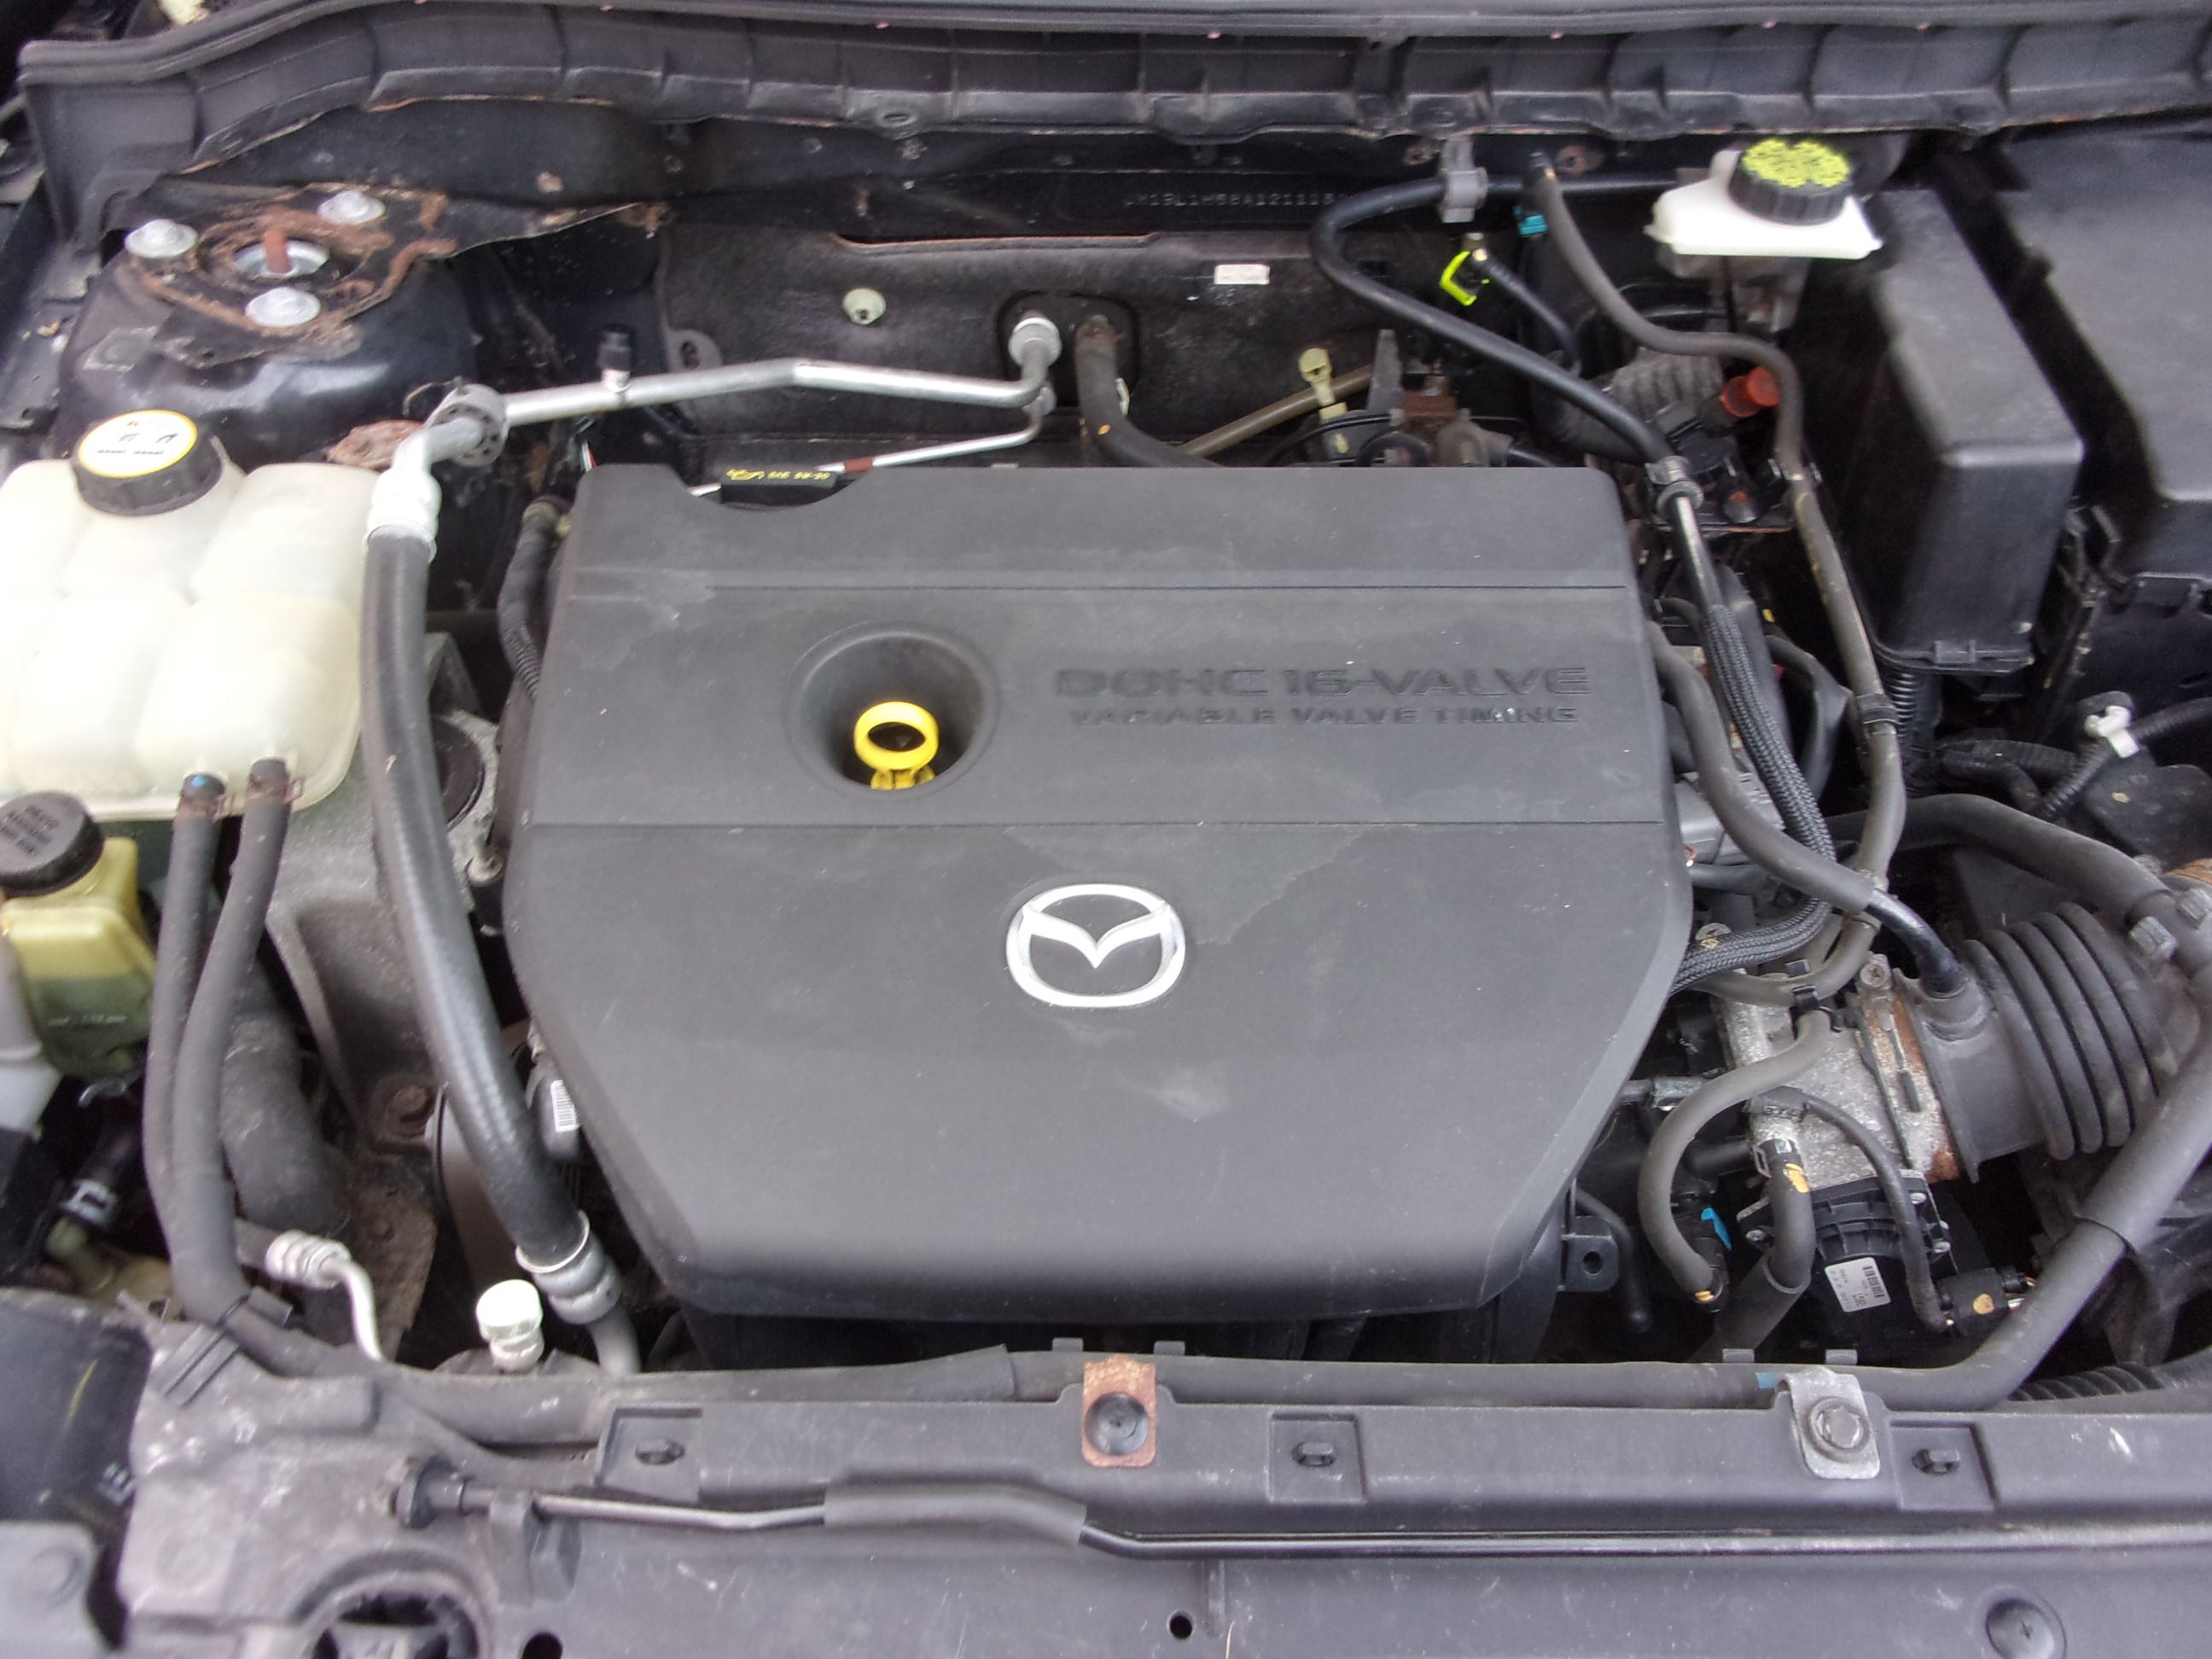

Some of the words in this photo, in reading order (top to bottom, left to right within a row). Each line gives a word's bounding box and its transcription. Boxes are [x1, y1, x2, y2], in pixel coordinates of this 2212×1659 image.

[1056, 668, 1270, 697] DOHC
[1282, 667, 1592, 697] 16-VALVE
[1070, 707, 1277, 725] VARIABLE
[1289, 707, 1419, 725] VALVE
[1434, 707, 1579, 724] TIMING
